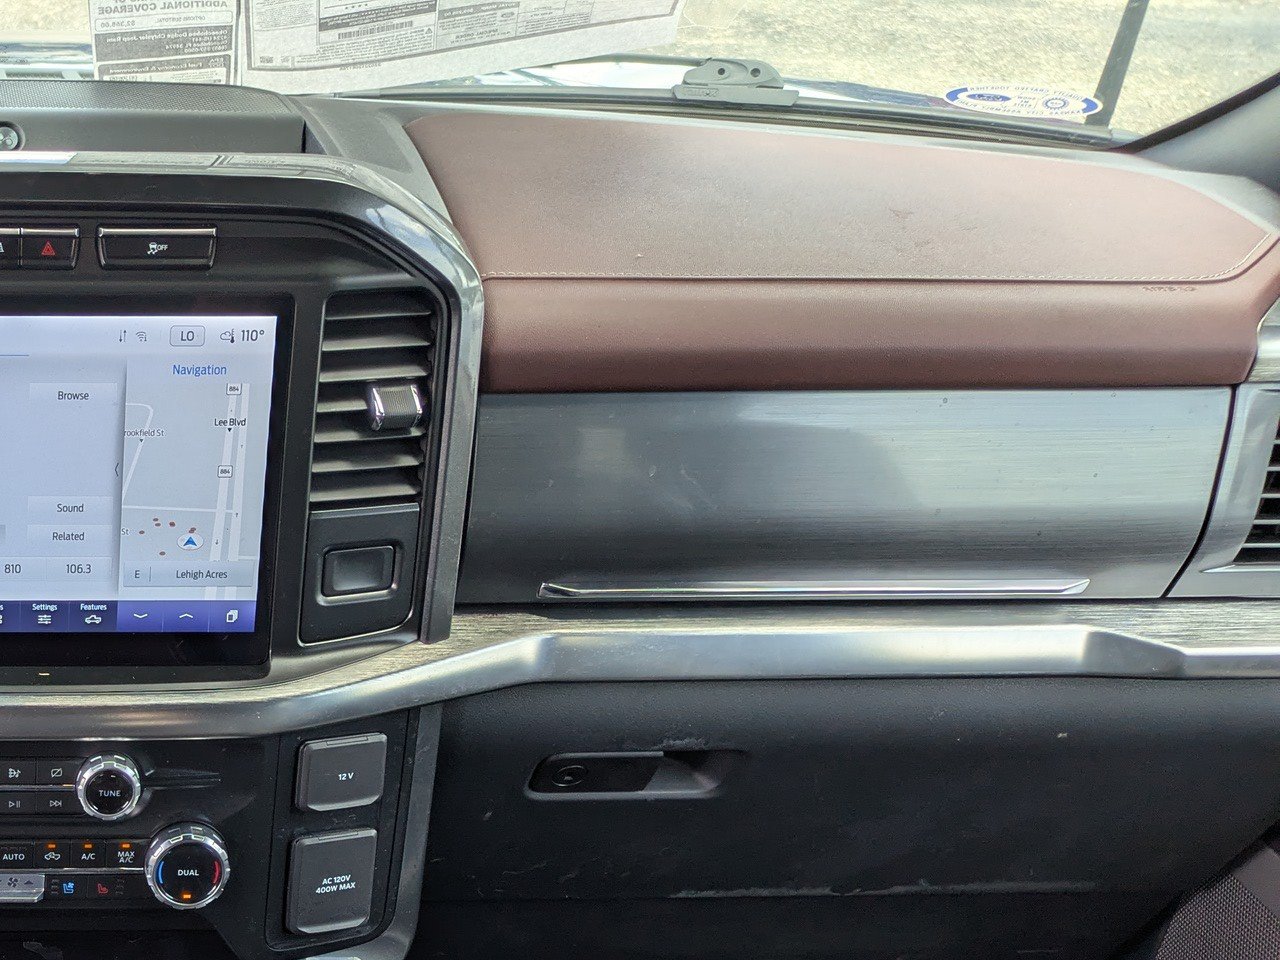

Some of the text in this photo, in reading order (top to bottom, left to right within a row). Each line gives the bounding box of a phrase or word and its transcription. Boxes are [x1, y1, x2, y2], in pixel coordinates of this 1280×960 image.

[180, 330, 195, 341] LO
[240, 329, 265, 342] 110°
[172, 363, 227, 377] Navigation
[57, 391, 89, 400] Browse
[214, 418, 246, 426] Lee Blvd
[124, 428, 165, 437] rookfield St
[56, 503, 84, 513] Sound
[52, 531, 85, 541] Related
[121, 527, 129, 536] St
[4, 563, 22, 574] 810
[65, 564, 92, 574] 106.3
[134, 570, 140, 579] E
[176, 569, 228, 580] Lehigh Acres
[32, 603, 58, 612] Settings
[80, 603, 107, 611] Features
[338, 772, 355, 781] 12 V
[98, 789, 121, 797] TUNE
[2, 853, 25, 861] AUTO
[81, 852, 96, 861] A/C
[177, 869, 200, 877] DUAL
[322, 875, 351, 885] AC 120V
[315, 882, 356, 894] 400W MAX
